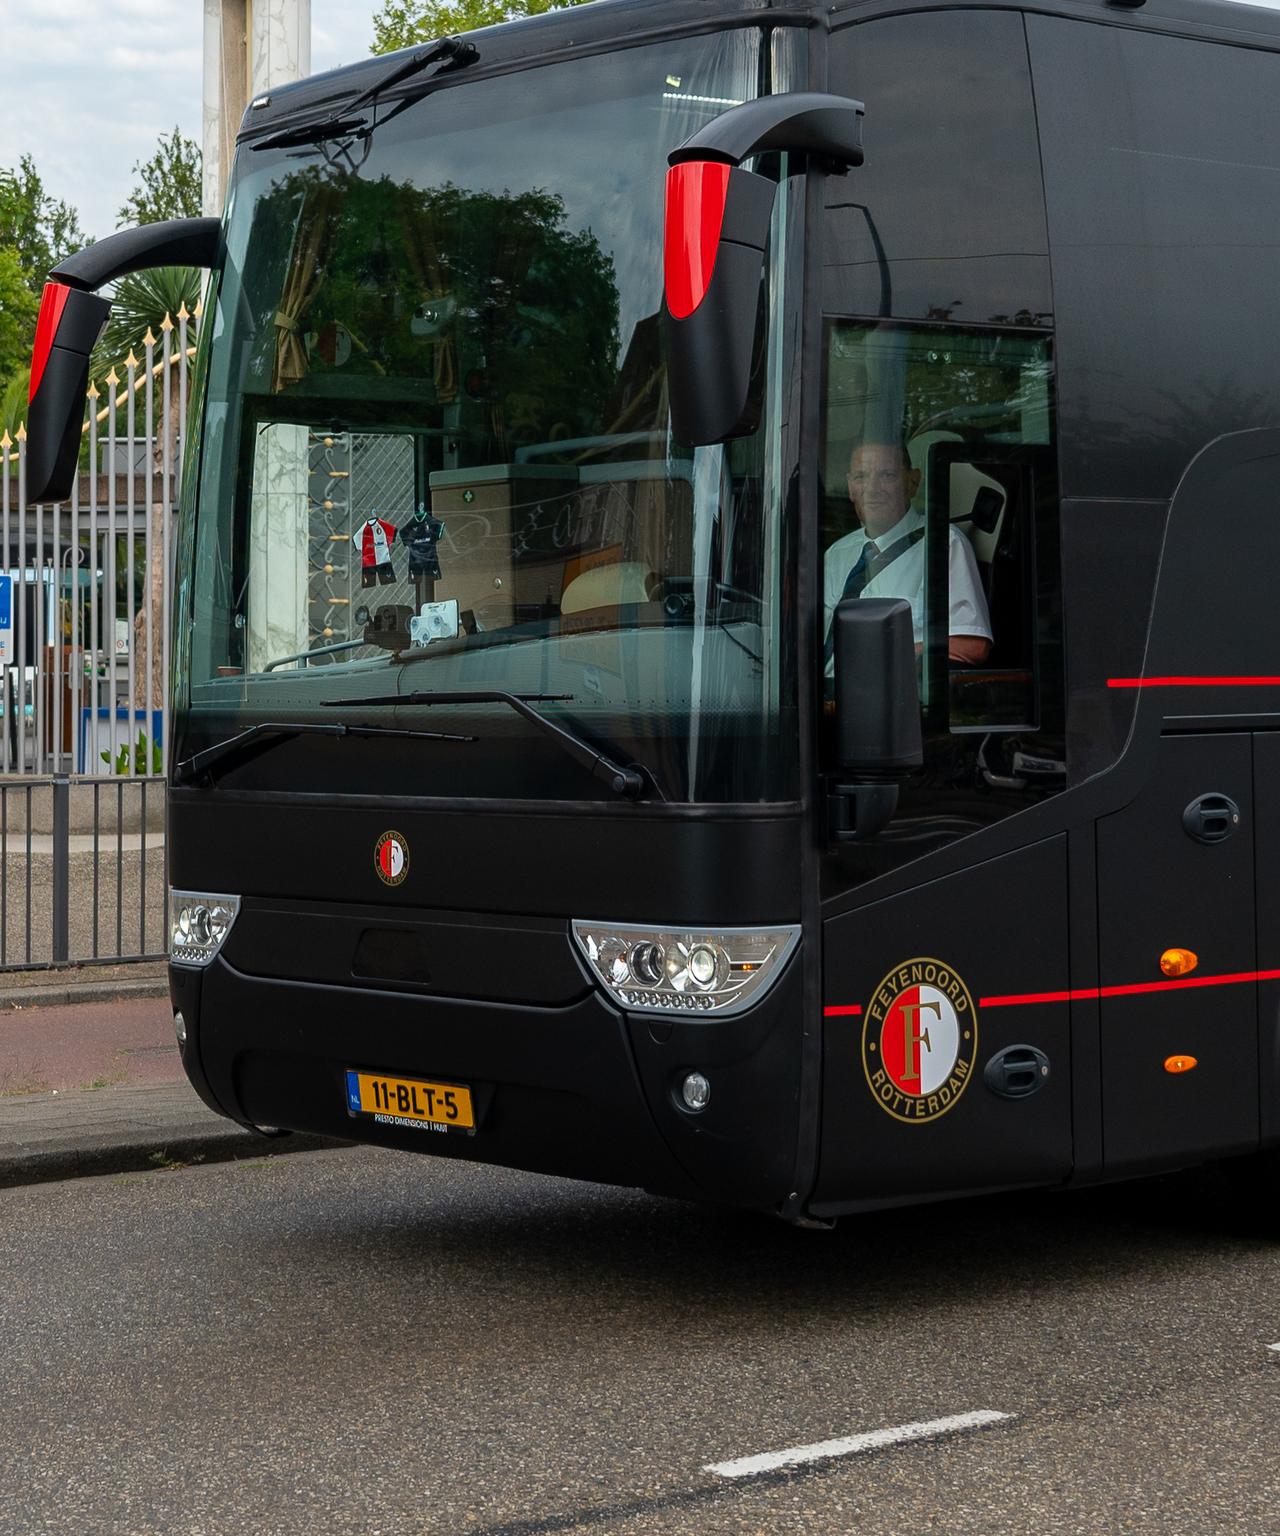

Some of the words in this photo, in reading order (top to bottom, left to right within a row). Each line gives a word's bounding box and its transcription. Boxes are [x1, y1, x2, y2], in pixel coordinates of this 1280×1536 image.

[871, 964, 968, 1021] FEYENOORD
[898, 1001, 942, 1081] F
[371, 1080, 458, 1120] 11-BLT-5
[872, 1058, 969, 1117] ROTTERDAM
[374, 1113, 395, 1125] PRESTO
[394, 1116, 429, 1130] DIMENSIONS
